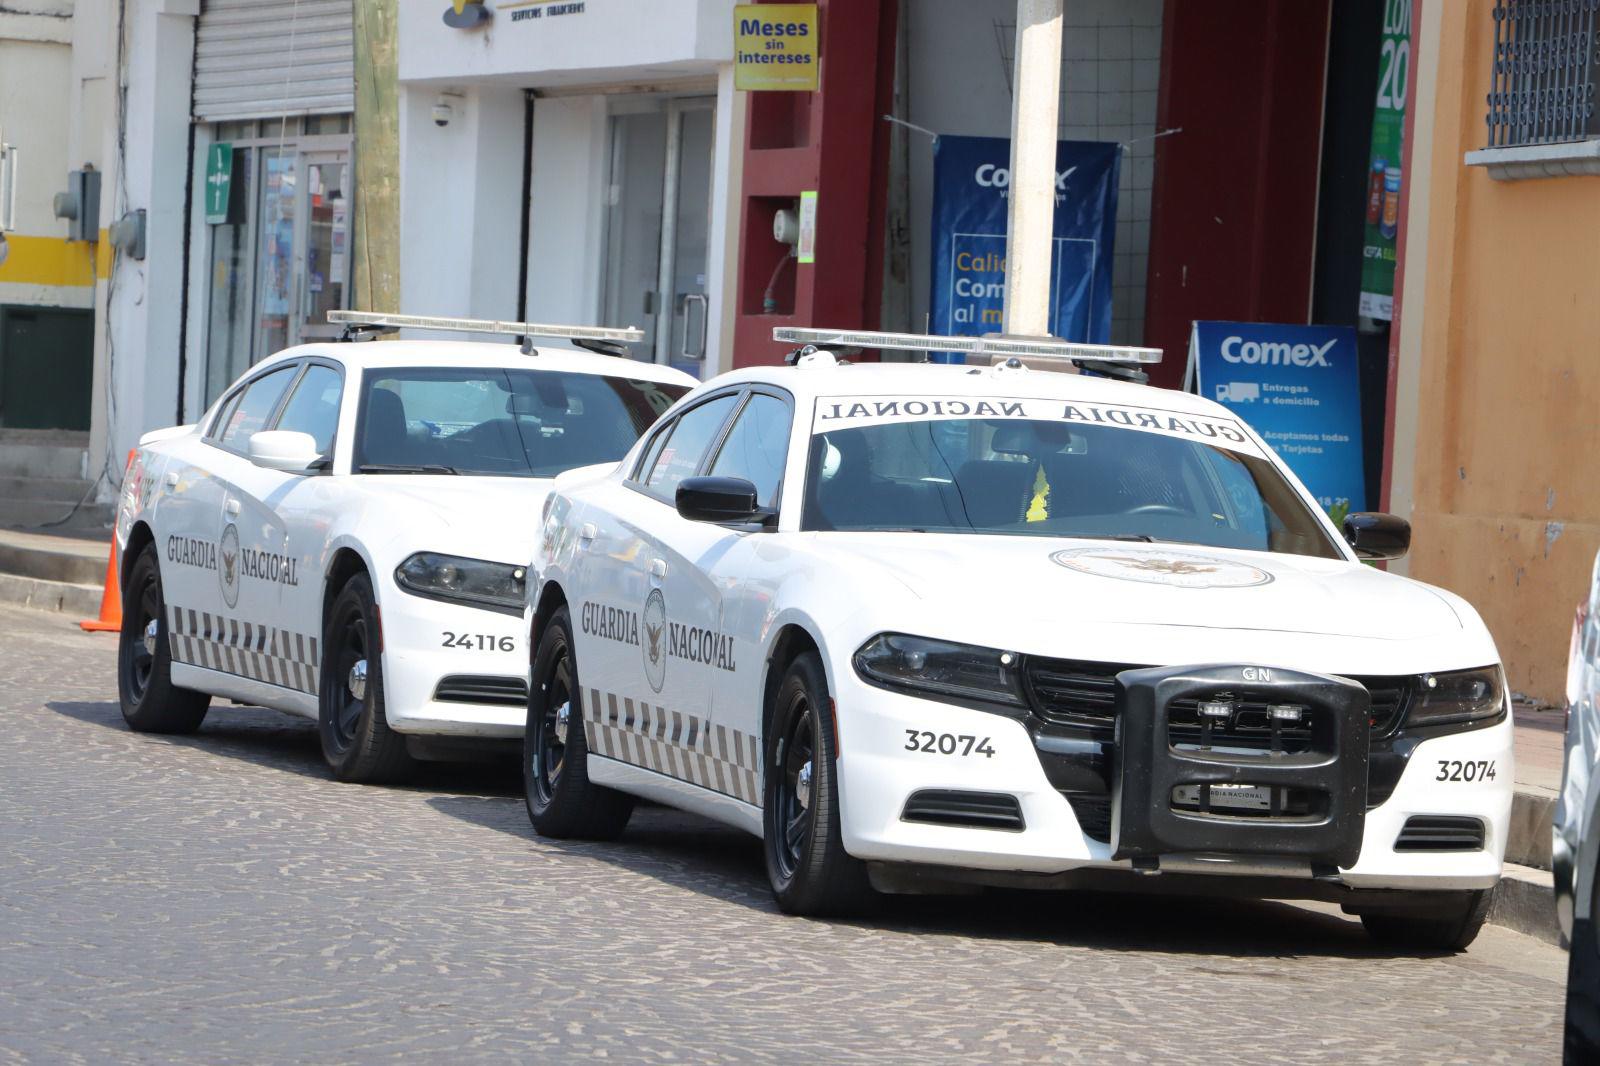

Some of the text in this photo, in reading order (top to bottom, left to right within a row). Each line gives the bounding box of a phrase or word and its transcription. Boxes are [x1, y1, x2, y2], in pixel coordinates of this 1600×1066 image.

[740, 19, 809, 37] Meses
[765, 38, 785, 50] sin
[738, 50, 812, 64] intereses
[975, 163, 1077, 190] Cox
[954, 303, 975, 323] al
[1220, 335, 1339, 368] Comex
[1262, 383, 1309, 394] Entregas
[1272, 396, 1320, 406] domicilio
[1263, 430, 1350, 442] Aceptamos todas
[1281, 443, 1323, 454] Tarjetas
[167, 534, 217, 571] GUARDIA
[581, 600, 640, 647] GUARDIA
[441, 631, 515, 652] 24116
[1242, 667, 1270, 682] GN
[904, 728, 996, 759] 32074
[1435, 760, 1496, 782] 32074
[1228, 791, 1263, 799] NACIONAL
